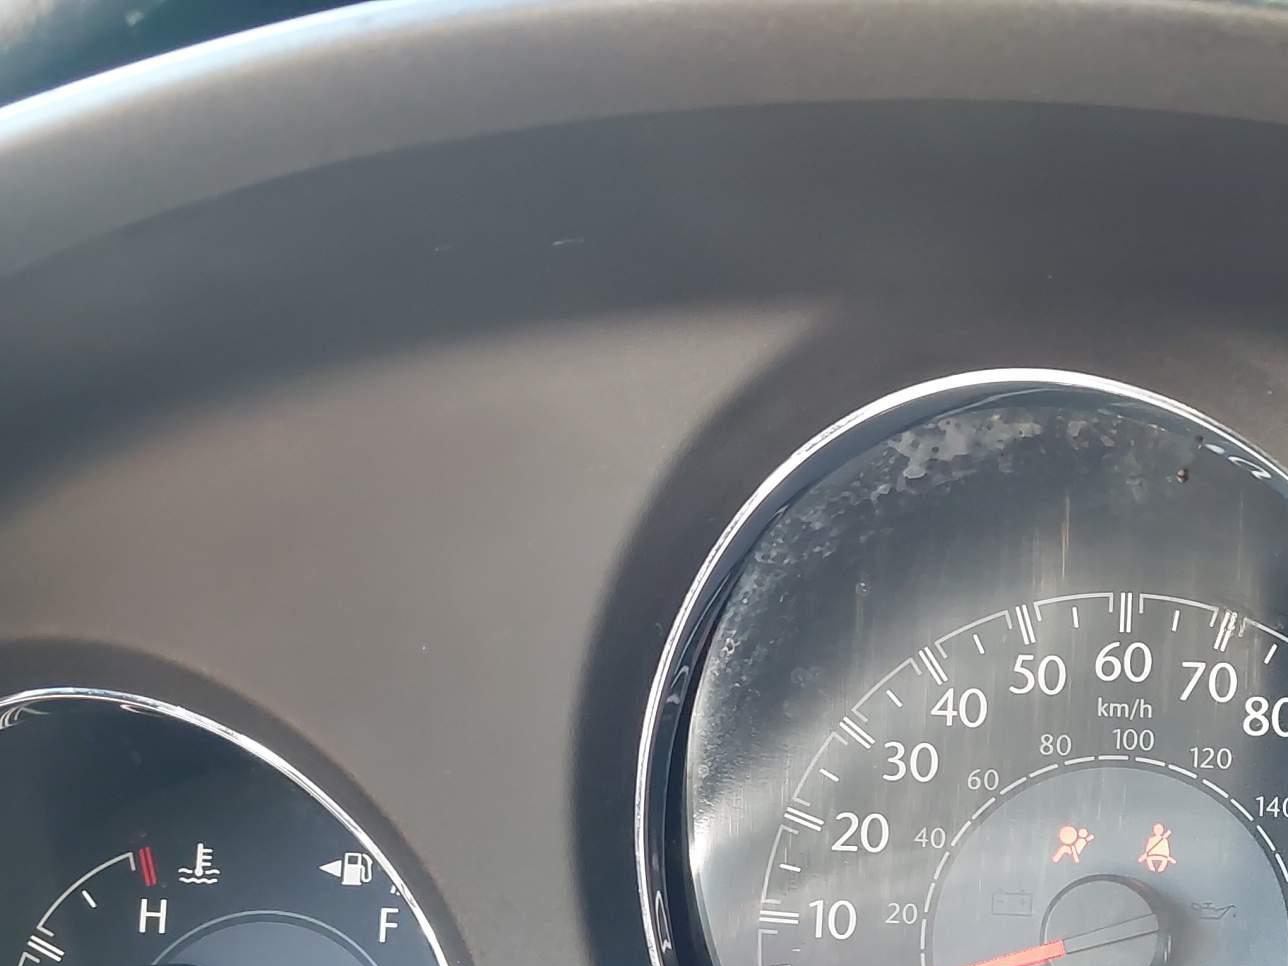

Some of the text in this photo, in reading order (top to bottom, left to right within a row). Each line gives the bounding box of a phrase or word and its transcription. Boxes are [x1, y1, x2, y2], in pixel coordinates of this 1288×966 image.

[1009, 655, 1066, 694] 50
[1094, 642, 1152, 683] 60
[1179, 662, 1238, 702] 70
[930, 688, 988, 727] 40
[1097, 698, 1153, 720] km/h
[1039, 734, 1072, 755] 80
[1112, 728, 1155, 751] 100
[882, 742, 939, 782] 30
[1191, 747, 1232, 769] 120
[967, 769, 1000, 791] 60
[831, 814, 889, 853] 20
[914, 827, 946, 848] 40
[138, 899, 168, 934] H
[379, 907, 399, 942] F
[808, 899, 857, 939] 10
[885, 903, 918, 924] 20
